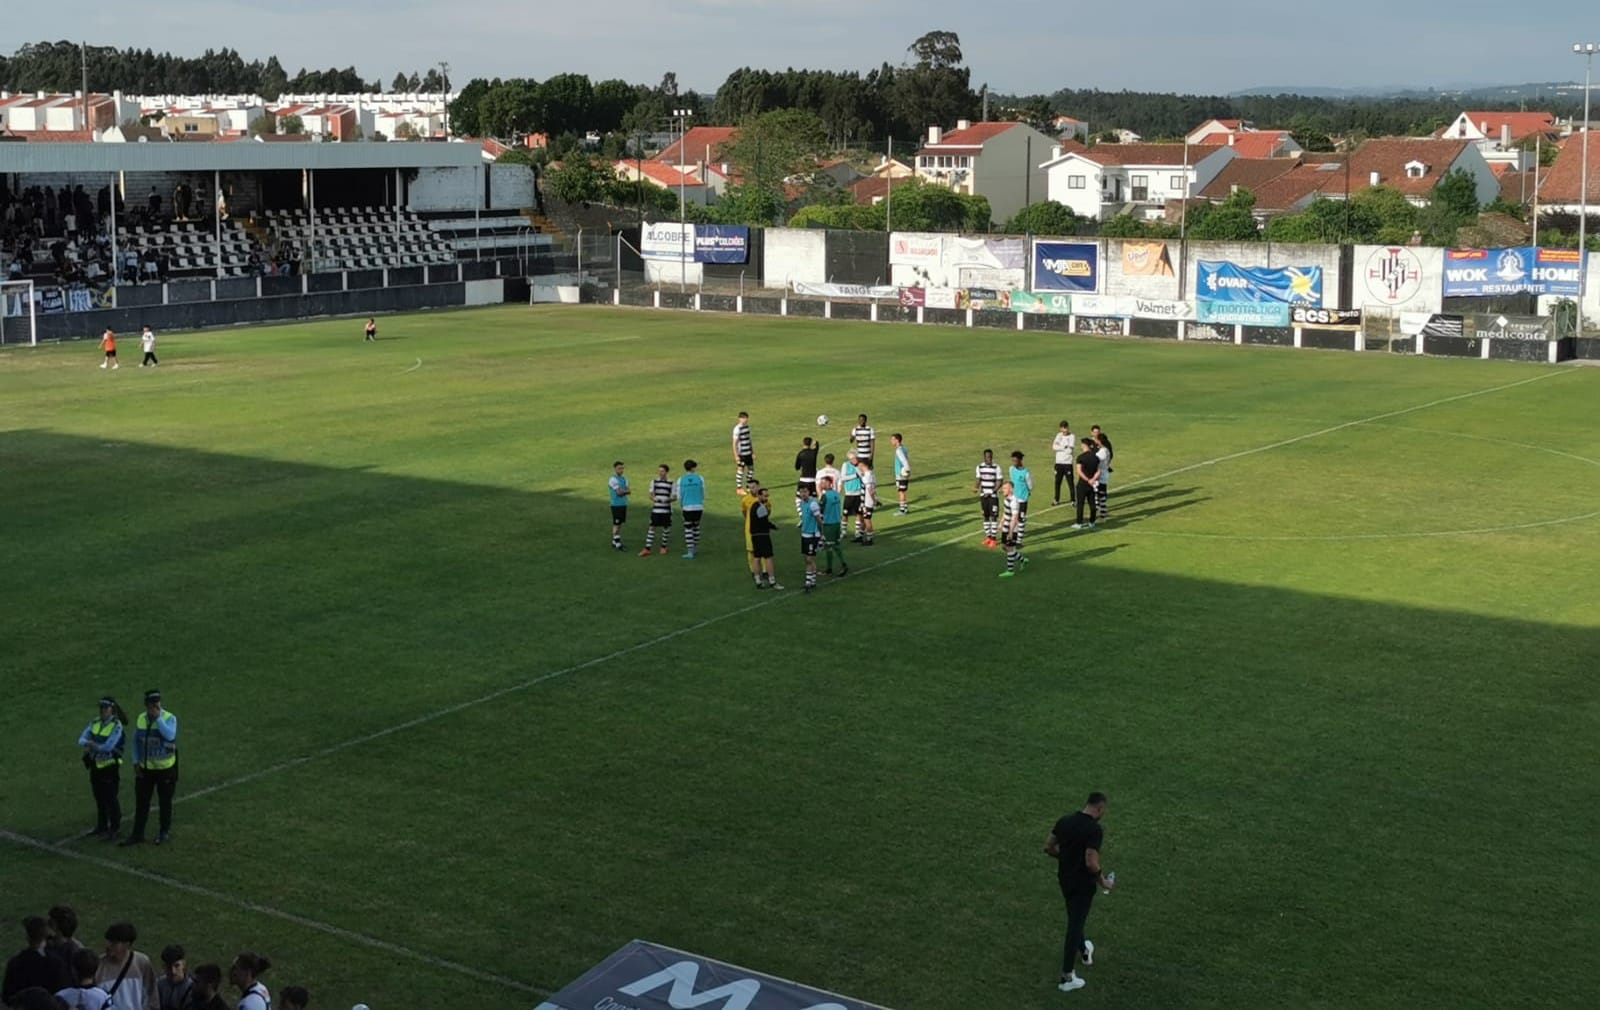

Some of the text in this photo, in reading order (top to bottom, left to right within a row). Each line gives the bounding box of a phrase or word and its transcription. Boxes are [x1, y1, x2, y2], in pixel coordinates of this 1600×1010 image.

[1447, 268, 1488, 281] WOK
[1218, 277, 1248, 288] OVAR
[1136, 300, 1177, 315] Valmet
[1294, 308, 1328, 322] acs
[1476, 328, 1547, 341] mediconta
